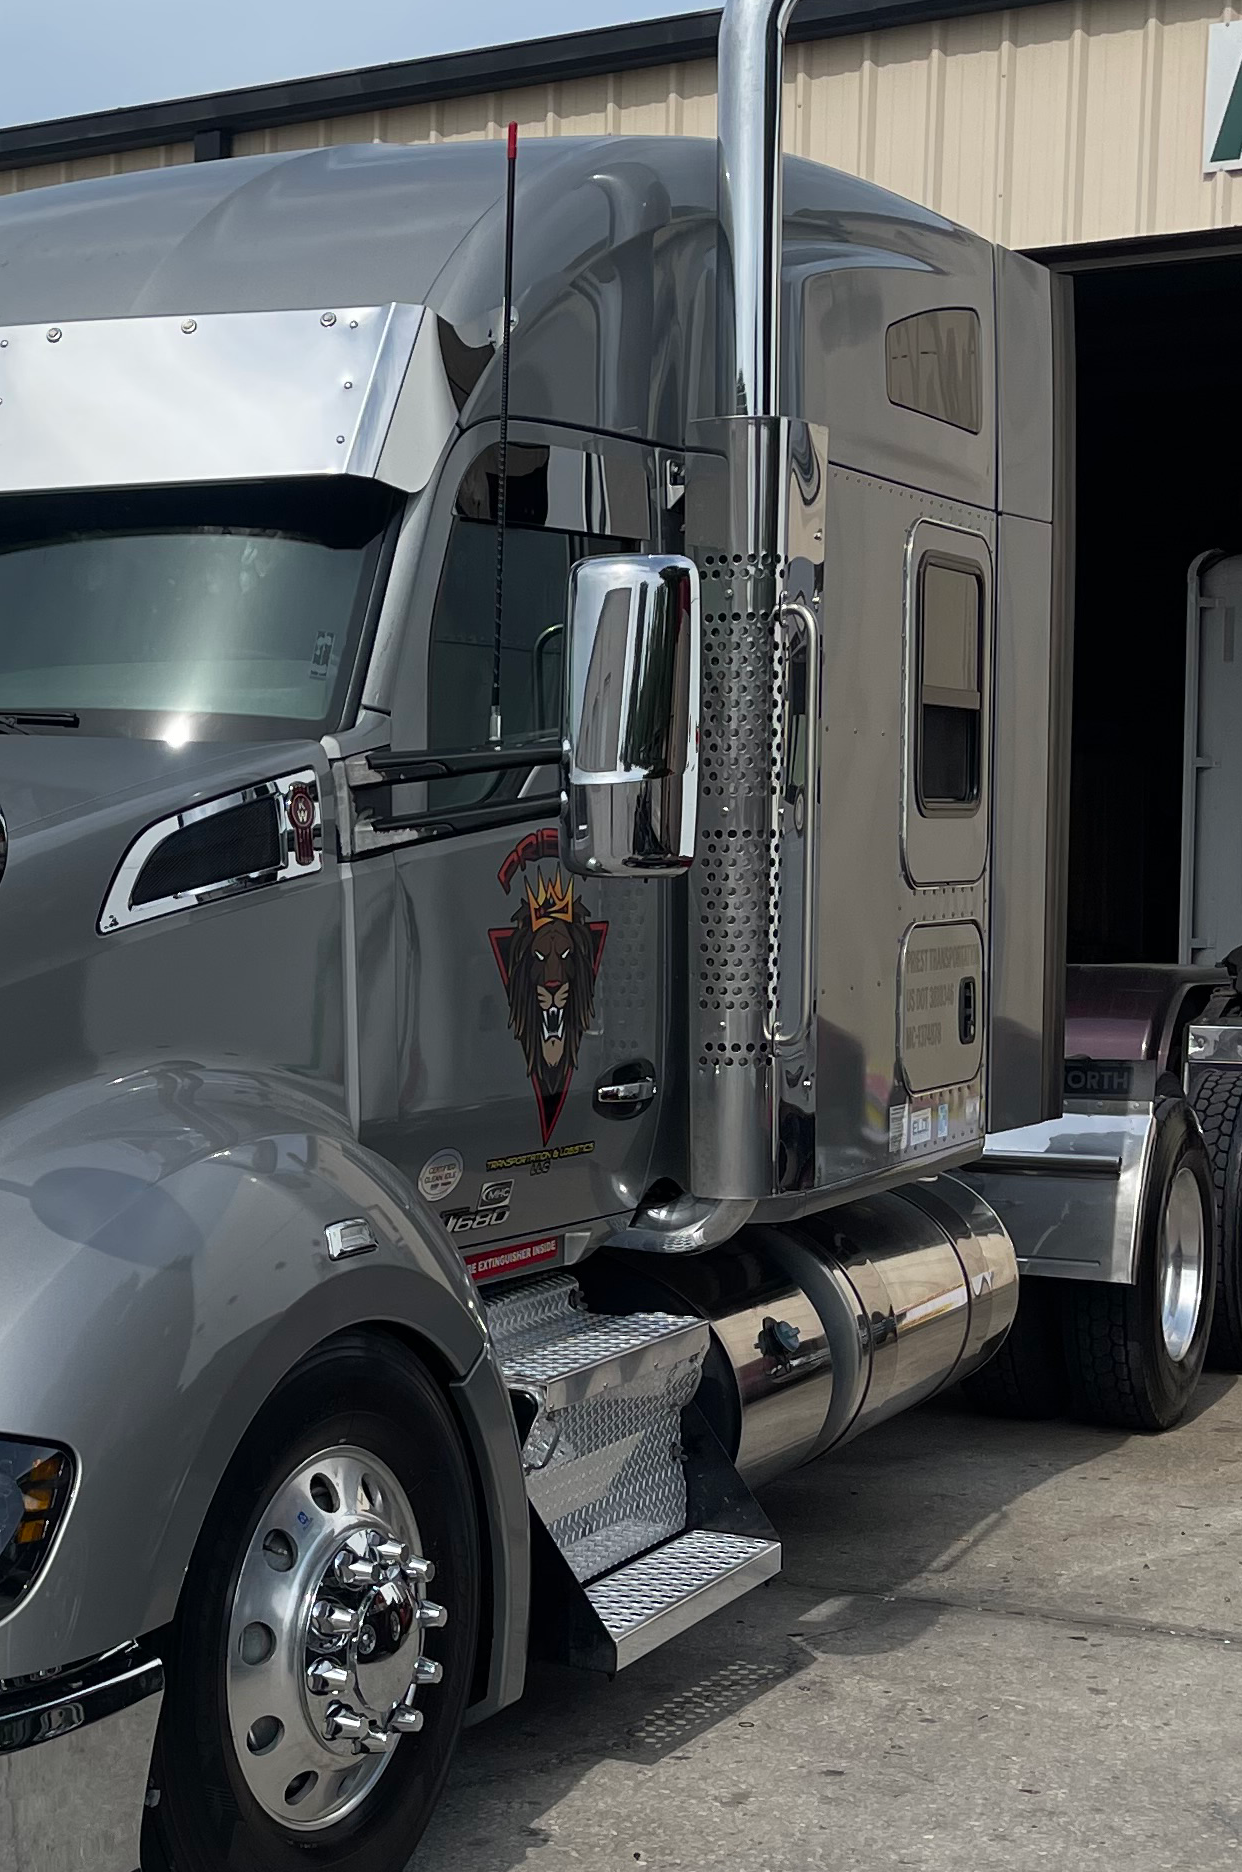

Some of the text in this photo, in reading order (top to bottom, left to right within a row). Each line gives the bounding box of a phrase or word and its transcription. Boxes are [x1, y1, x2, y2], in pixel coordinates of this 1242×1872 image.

[916, 986, 929, 1010] DOT
[1067, 1070, 1128, 1090] ORTH
[486, 1150, 552, 1170] TRANSPORTATION
[559, 1142, 595, 1157] LOGISTICS
[424, 1171, 457, 1184] CLEAN IDLE
[529, 1160, 551, 1176] LLC
[488, 1187, 511, 1200] MHC
[466, 1239, 557, 1274] RE EXTINGUISHER INSIDE
